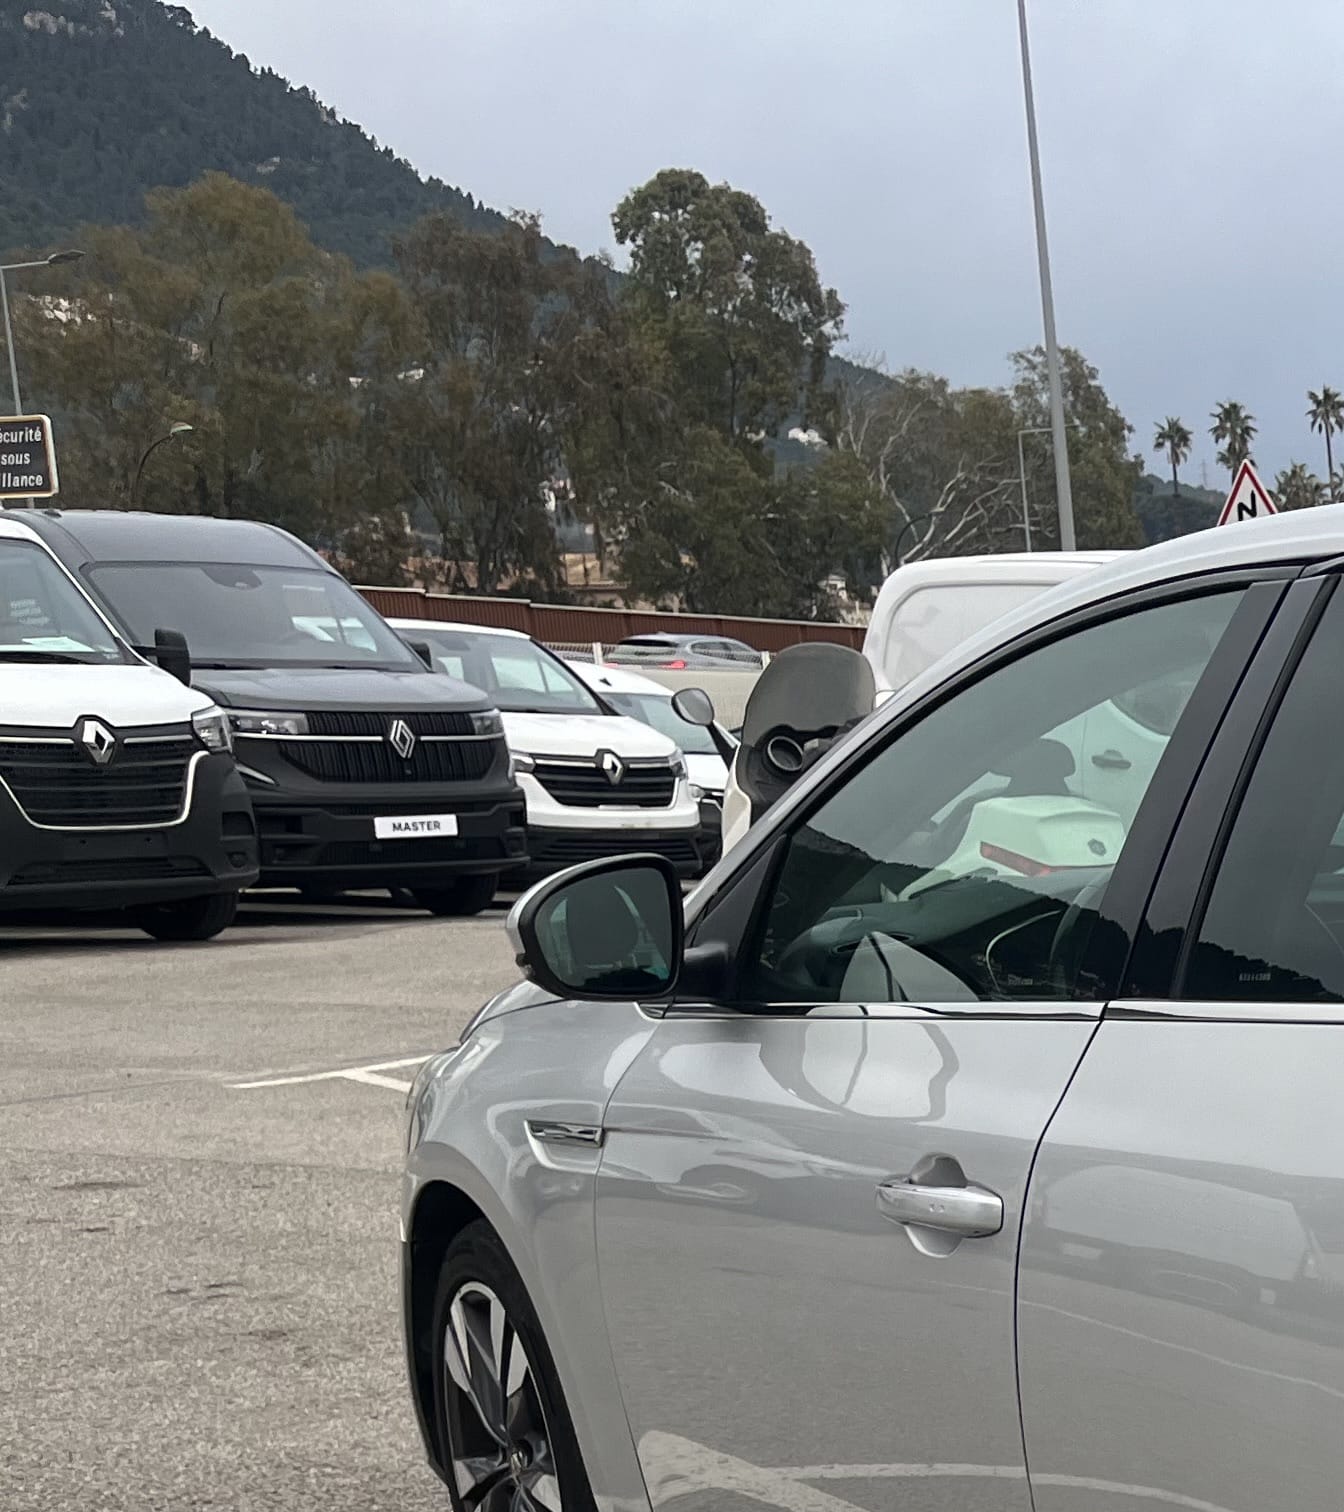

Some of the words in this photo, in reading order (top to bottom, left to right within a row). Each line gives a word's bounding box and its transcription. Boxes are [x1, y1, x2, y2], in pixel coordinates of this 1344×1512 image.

[0, 426, 42, 444] curité
[0, 452, 31, 466] sous
[392, 820, 441, 833] MASTER
